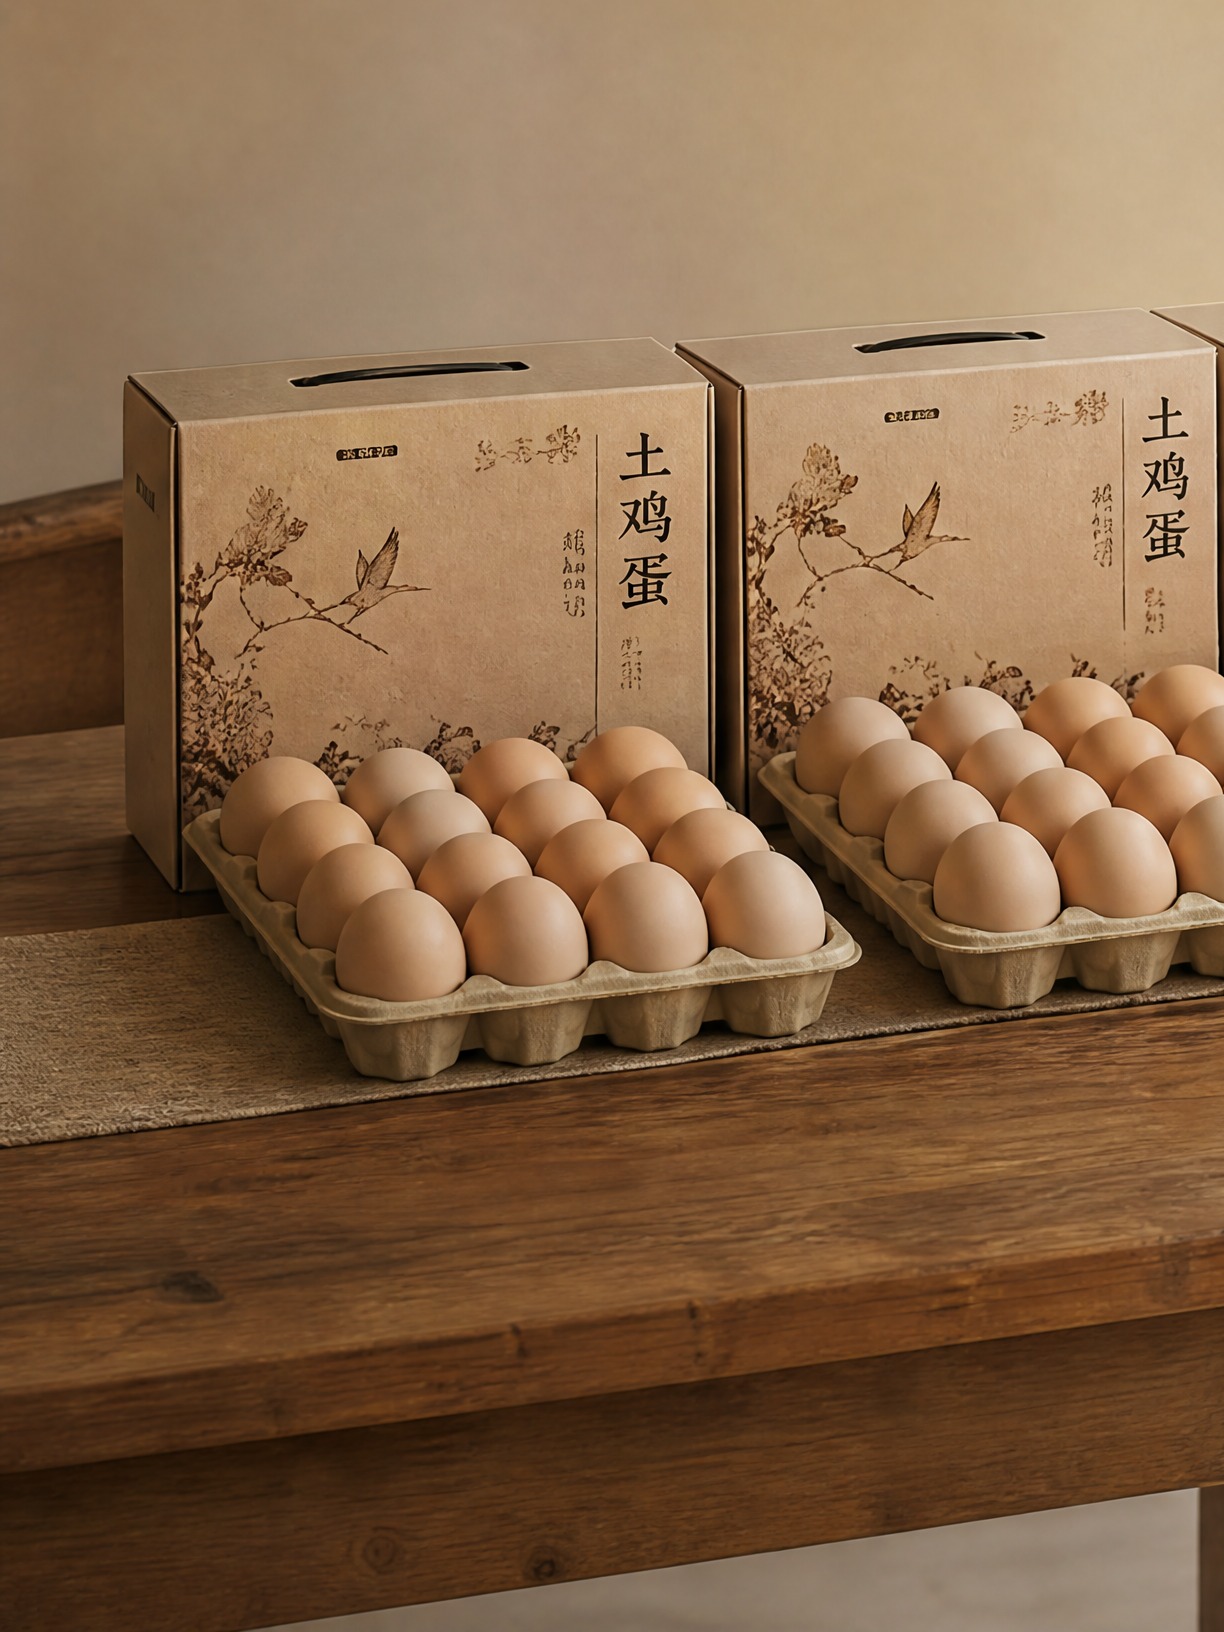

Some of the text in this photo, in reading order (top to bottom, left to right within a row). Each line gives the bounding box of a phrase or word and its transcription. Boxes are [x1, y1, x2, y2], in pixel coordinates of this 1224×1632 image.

[618, 432, 672, 609] 土鸡蛋
[1140, 396, 1190, 563] 土鸡蛋
